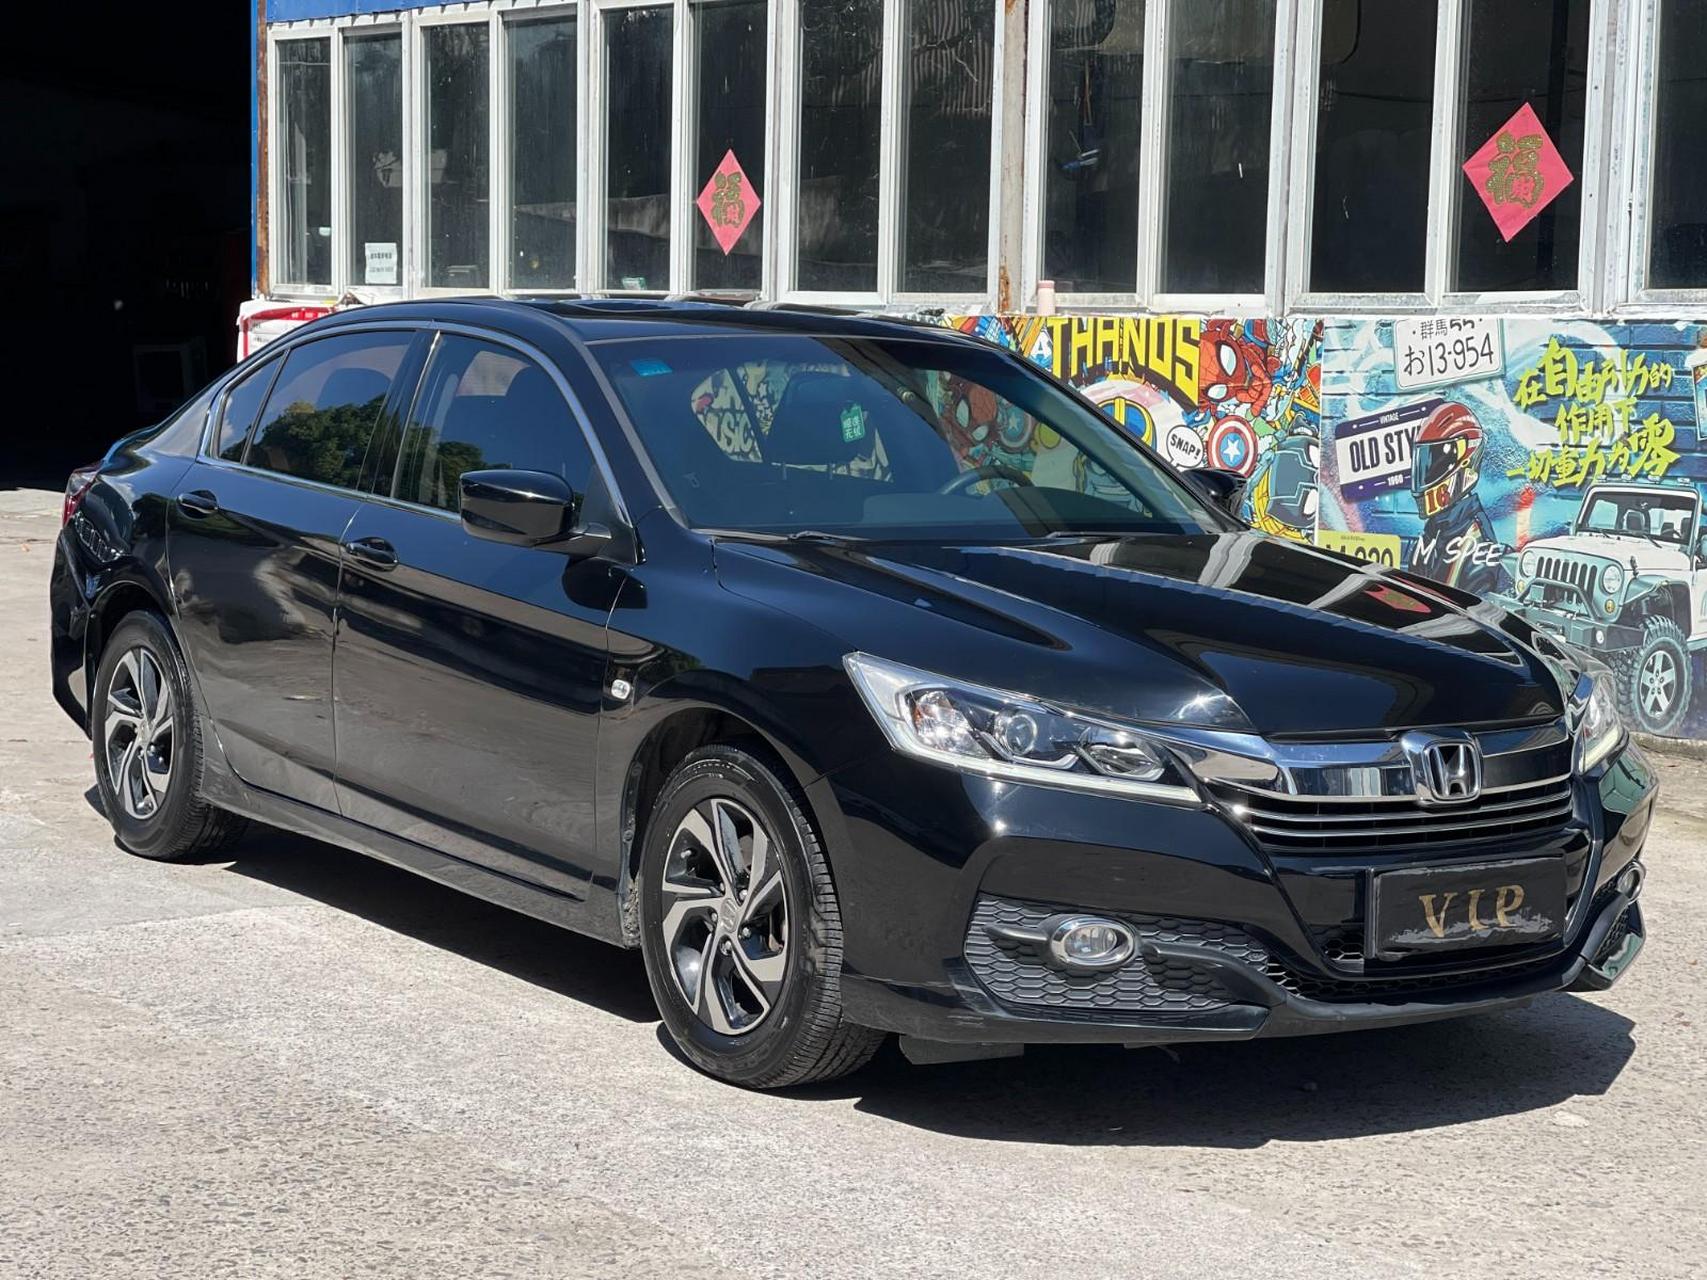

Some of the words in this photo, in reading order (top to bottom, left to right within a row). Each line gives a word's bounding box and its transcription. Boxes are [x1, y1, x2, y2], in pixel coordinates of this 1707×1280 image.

[1047, 316, 1201, 406] THANOS
[1403, 332, 1494, 377] お13-954
[1554, 396, 1638, 444] 作用下
[1169, 433, 1201, 460] SNAP!
[1350, 436, 1380, 473] OLD
[1419, 884, 1525, 938] VIP
